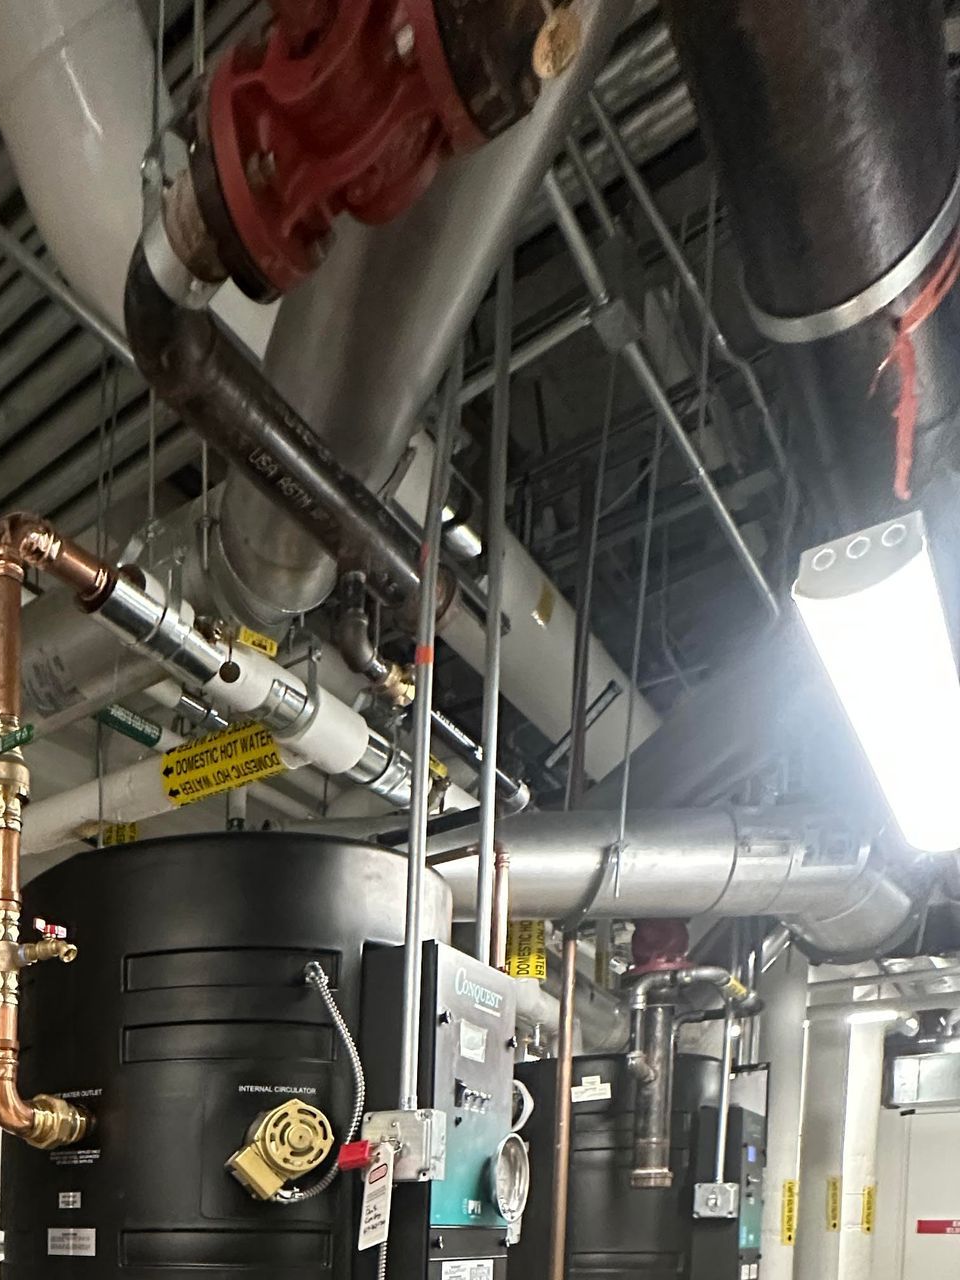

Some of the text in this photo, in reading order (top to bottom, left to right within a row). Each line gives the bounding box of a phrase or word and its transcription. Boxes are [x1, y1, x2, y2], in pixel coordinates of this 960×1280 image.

[248, 447, 312, 508] USA ASTM
[176, 747, 219, 776] DOMESTIC
[220, 739, 239, 760] HOT
[241, 730, 273, 753] WATER
[180, 752, 280, 795] DOMESTIC HOT WATER
[517, 920, 533, 975] DOMESTIC HO
[536, 947, 545, 976] WATER
[62, 1088, 103, 1099] WATER OUTLET
[238, 1085, 317, 1095] INTERNAL CIRCULATOR
